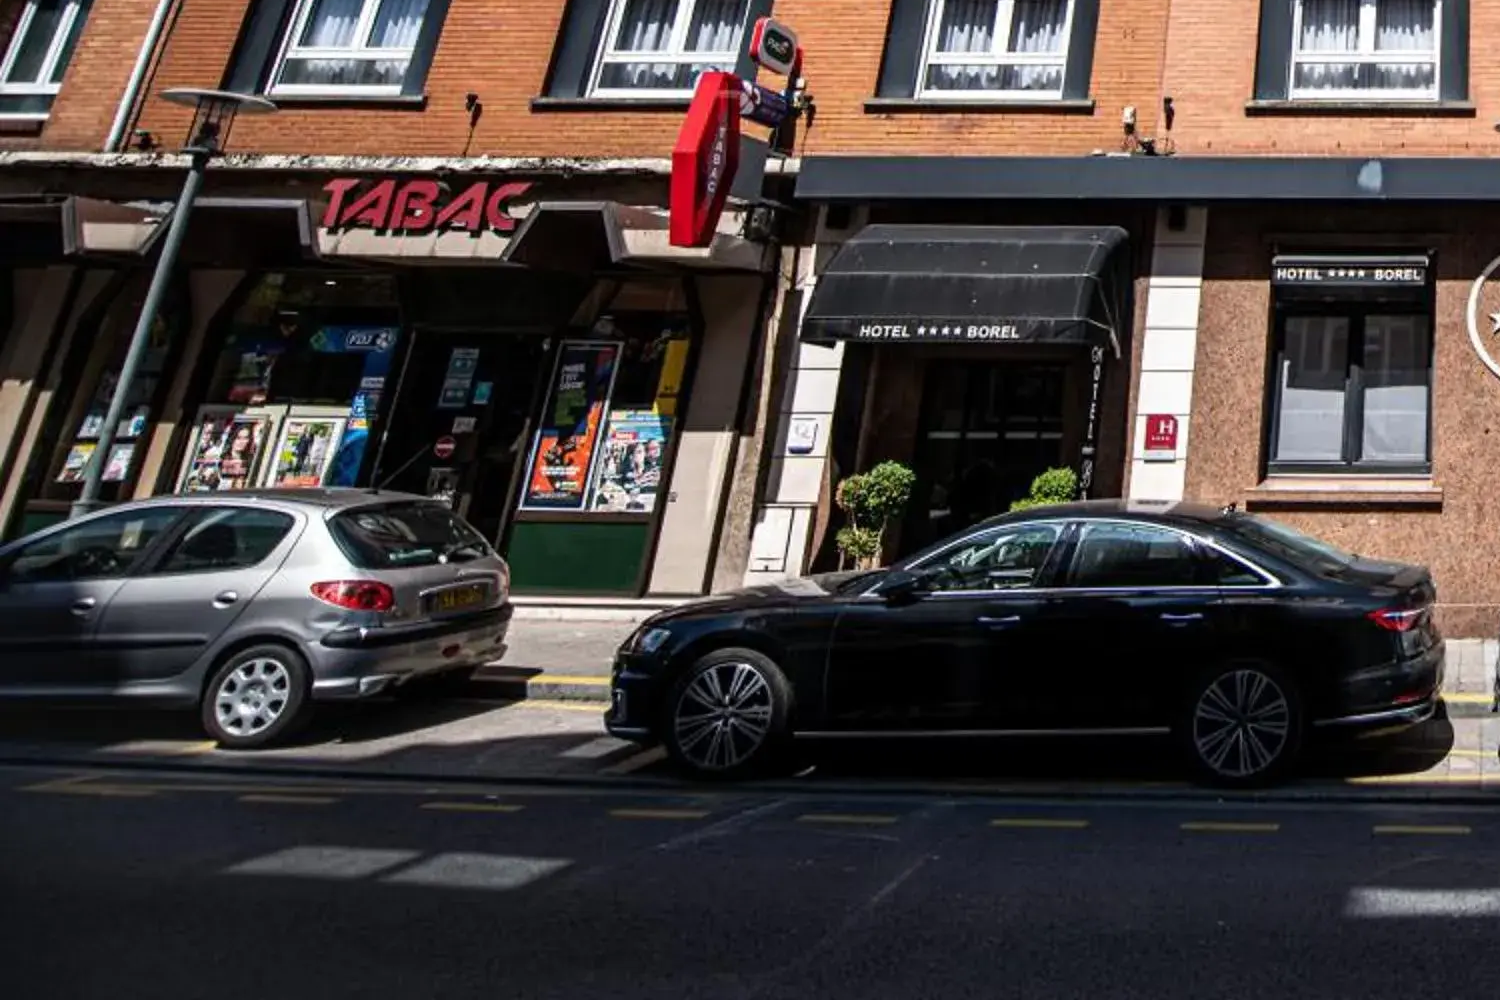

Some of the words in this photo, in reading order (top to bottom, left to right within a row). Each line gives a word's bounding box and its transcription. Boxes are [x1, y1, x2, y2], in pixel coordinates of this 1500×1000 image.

[707, 127, 727, 194] TABAC
[322, 177, 535, 232] TABAC
[1276, 268, 1323, 281] HOTEL
[1373, 268, 1421, 281] BOREL
[859, 324, 911, 337] HOTEL
[966, 324, 1020, 338] BOREL
[1159, 419, 1174, 435] H
